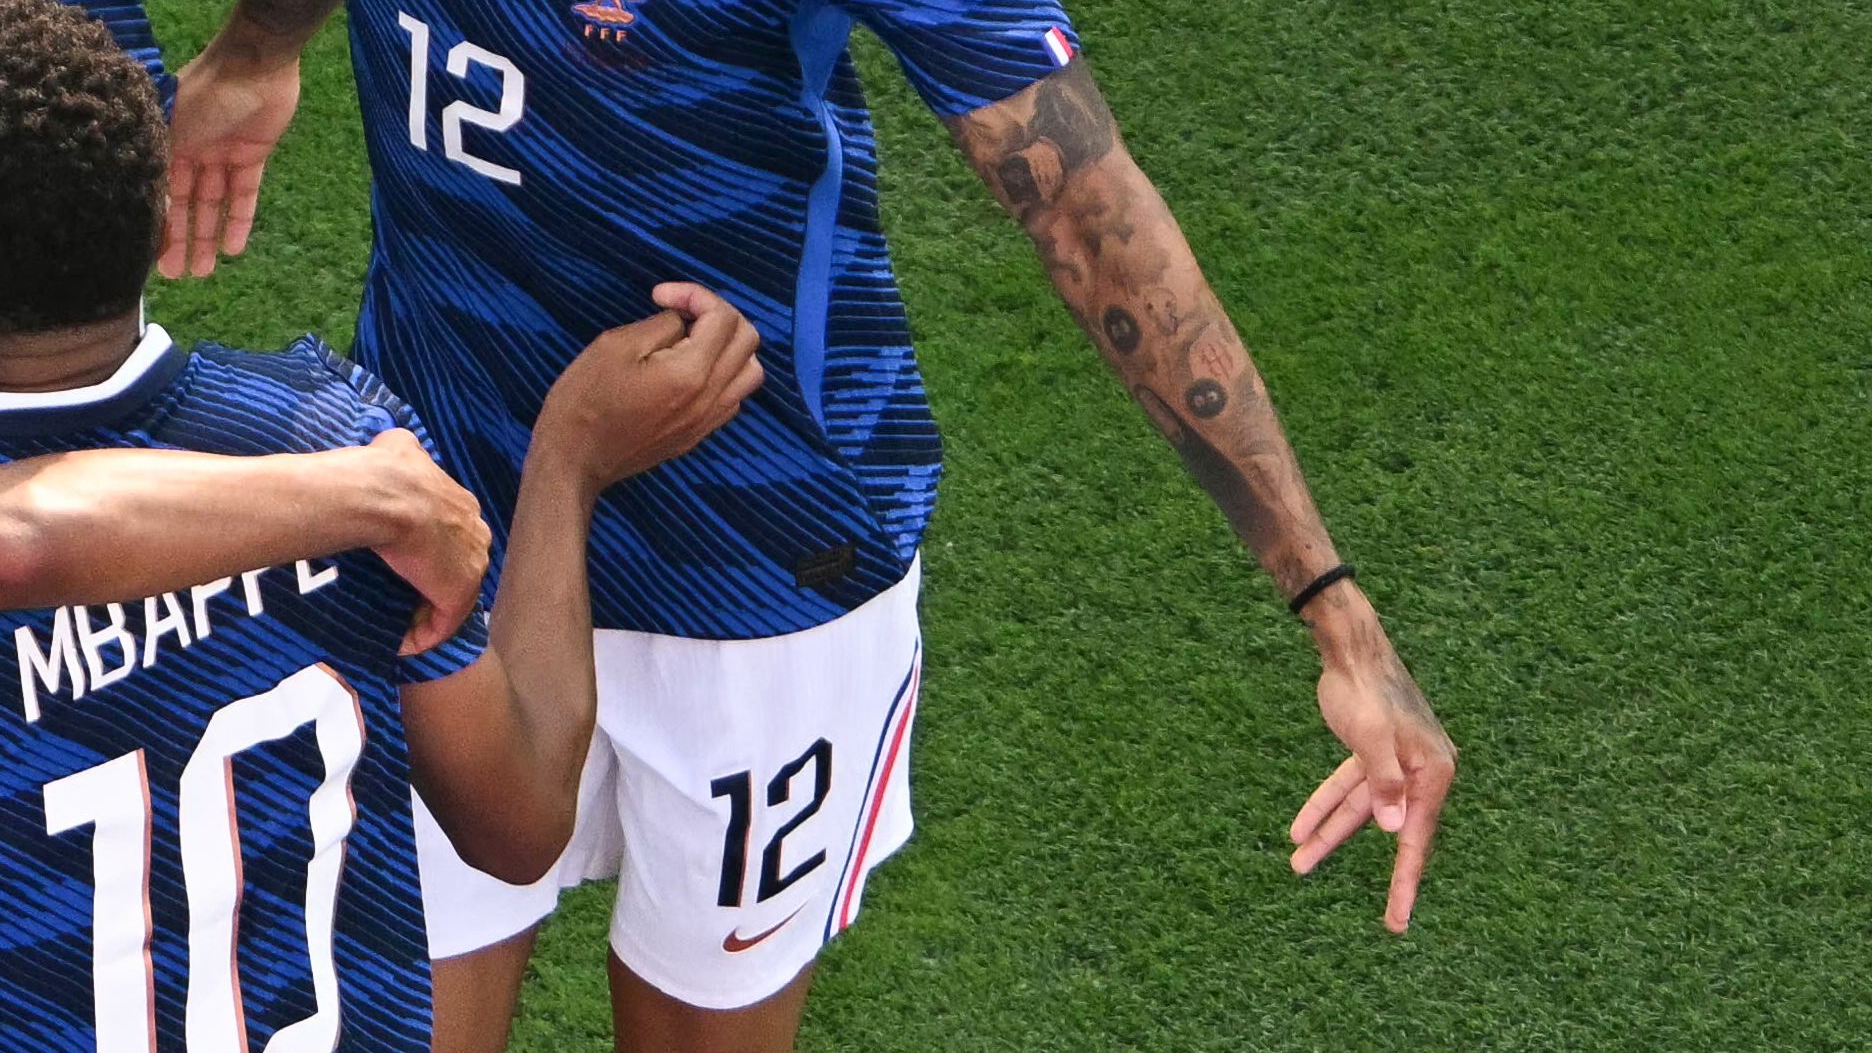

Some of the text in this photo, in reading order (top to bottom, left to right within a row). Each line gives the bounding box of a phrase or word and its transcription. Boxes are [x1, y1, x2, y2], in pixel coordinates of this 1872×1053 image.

[398, 10, 524, 186] 12
[42, 661, 366, 1053] 10
[710, 737, 833, 908] 12
